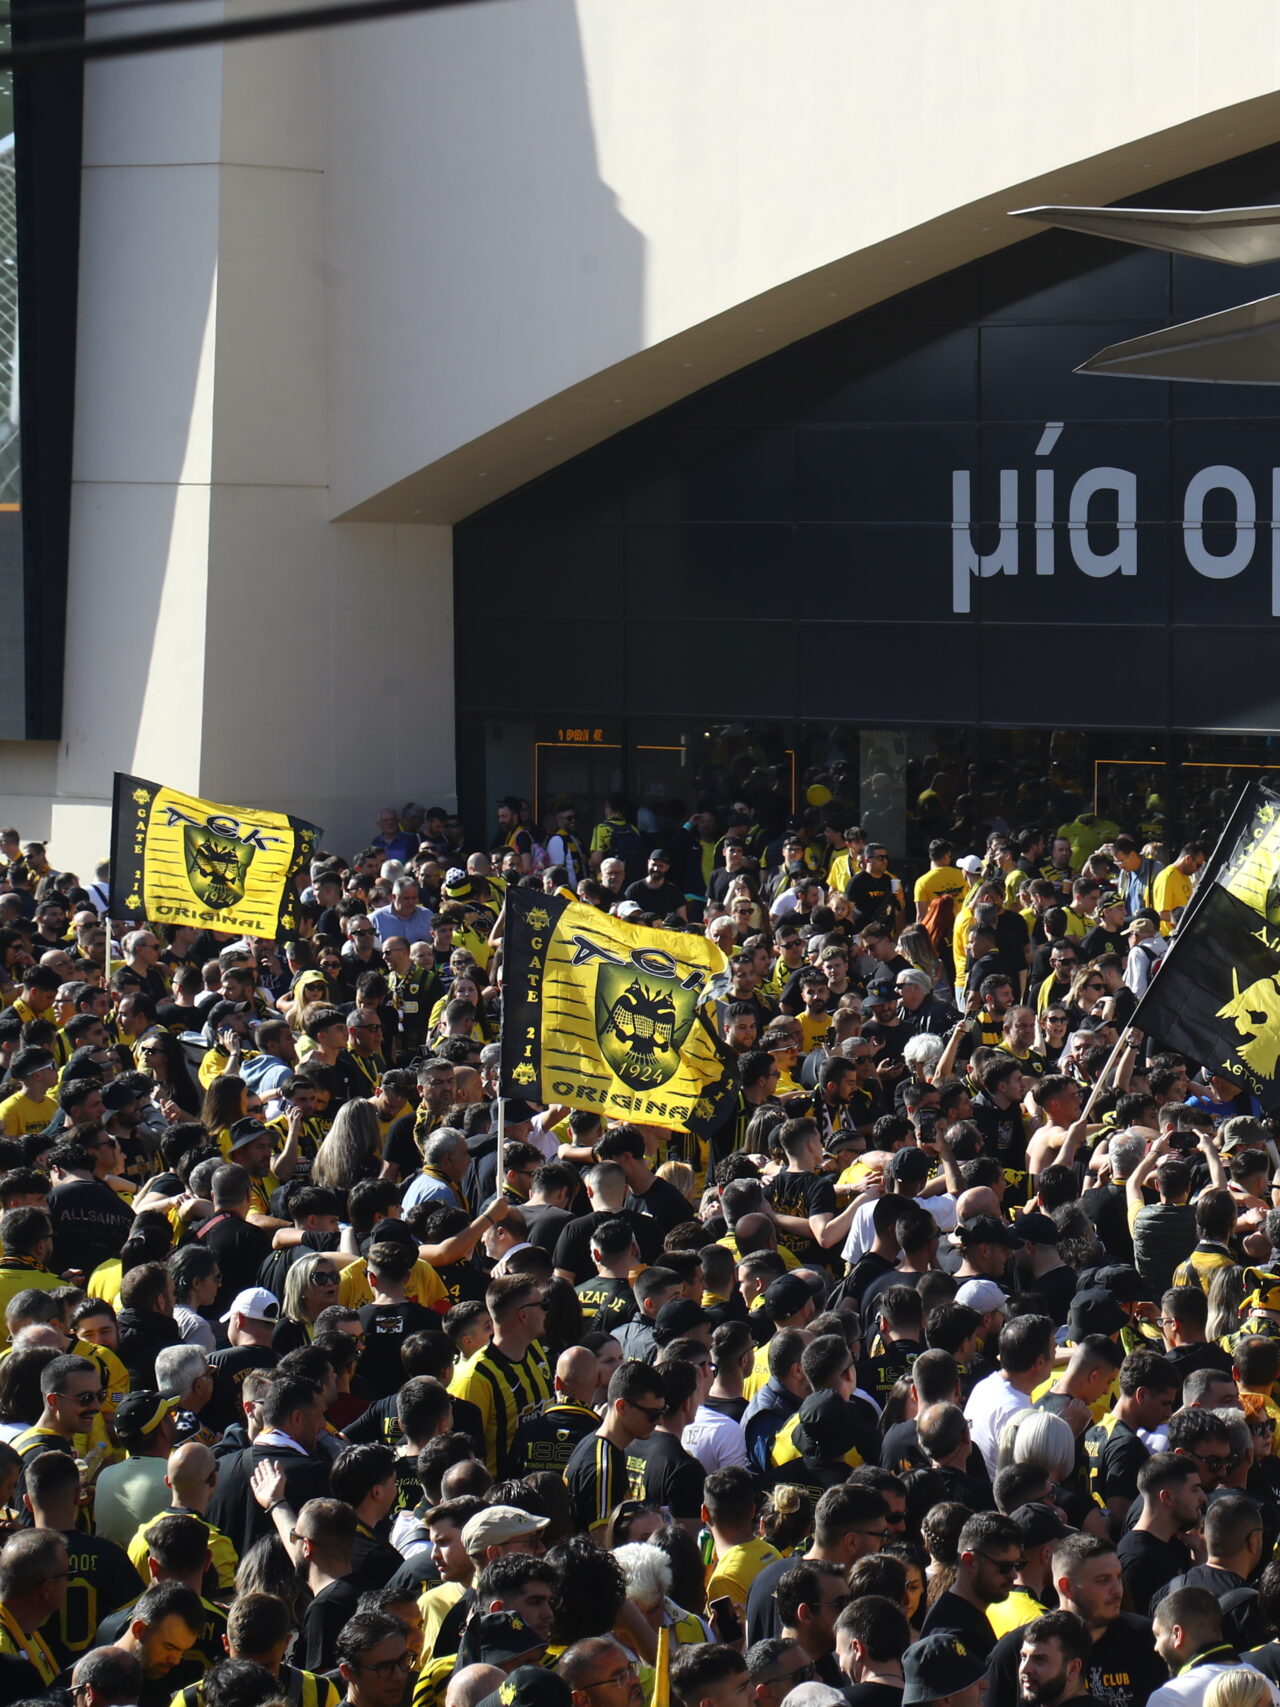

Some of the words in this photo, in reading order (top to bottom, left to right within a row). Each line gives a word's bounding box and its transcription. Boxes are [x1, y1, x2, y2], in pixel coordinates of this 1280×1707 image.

[203, 890, 235, 905] 1924
[155, 905, 266, 930] ORIGINAL
[525, 936, 543, 1003] GATE
[523, 1026, 536, 1058] 21
[618, 1061, 664, 1085] 1924
[551, 1080, 691, 1121] ORIGINA
[1103, 1672, 1130, 1687] CLUB
